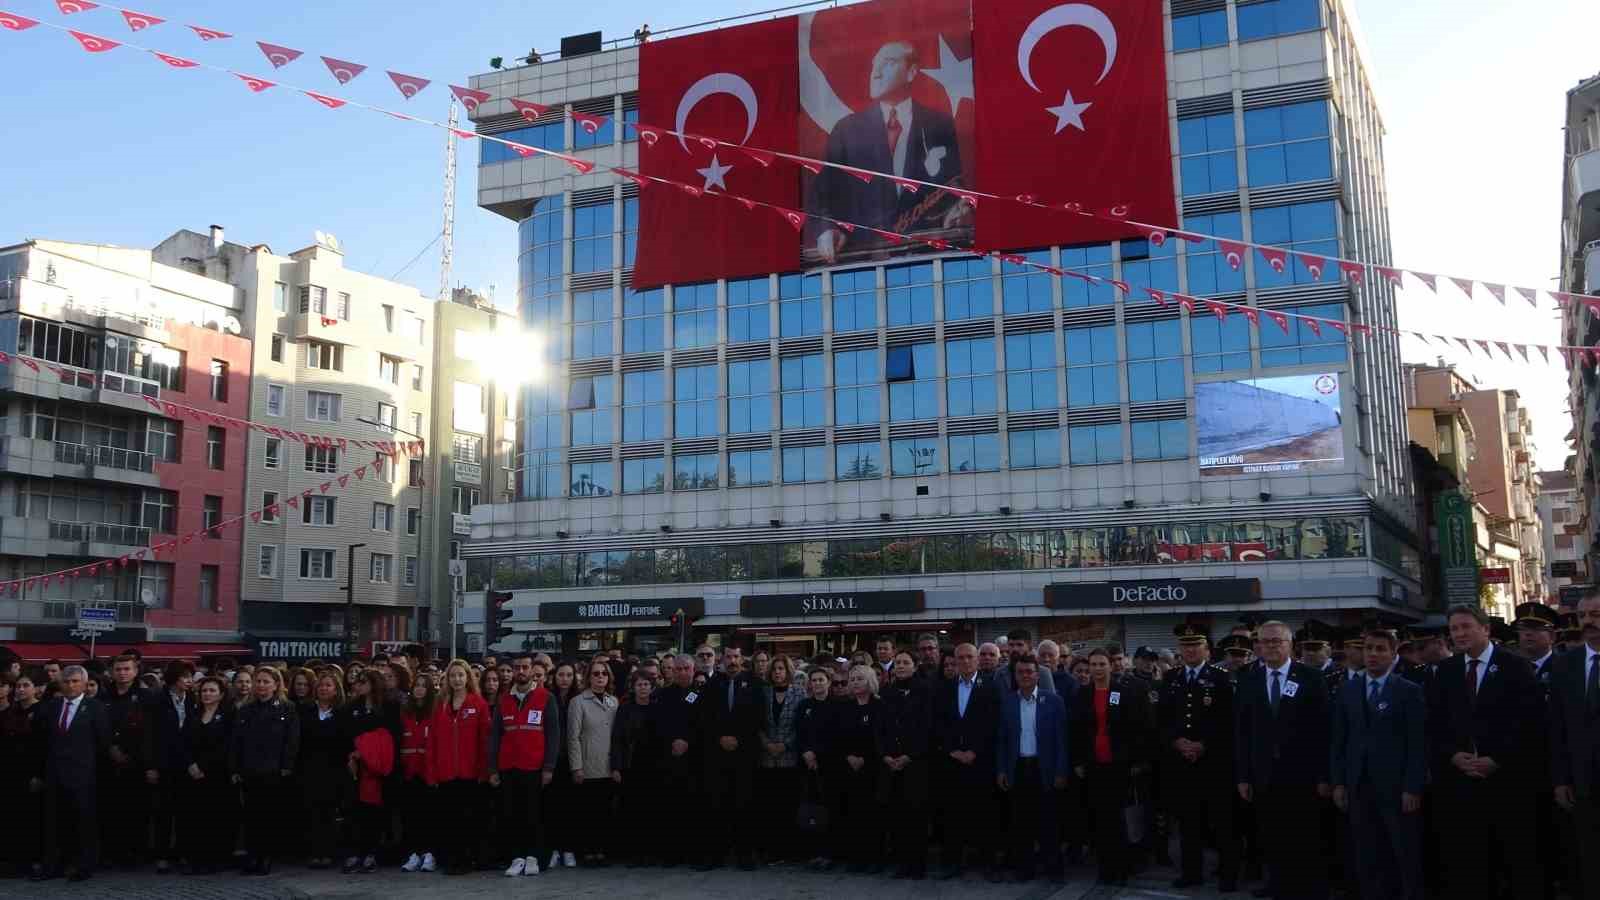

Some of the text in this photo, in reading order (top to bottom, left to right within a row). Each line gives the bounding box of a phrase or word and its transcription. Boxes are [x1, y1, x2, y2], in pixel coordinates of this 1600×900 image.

[1112, 585, 1187, 602] DeFacto
[588, 603, 662, 617] BARGELLO PERFUME
[802, 595, 857, 613] ŞİMAL
[259, 641, 342, 657] TAHTAKALE
